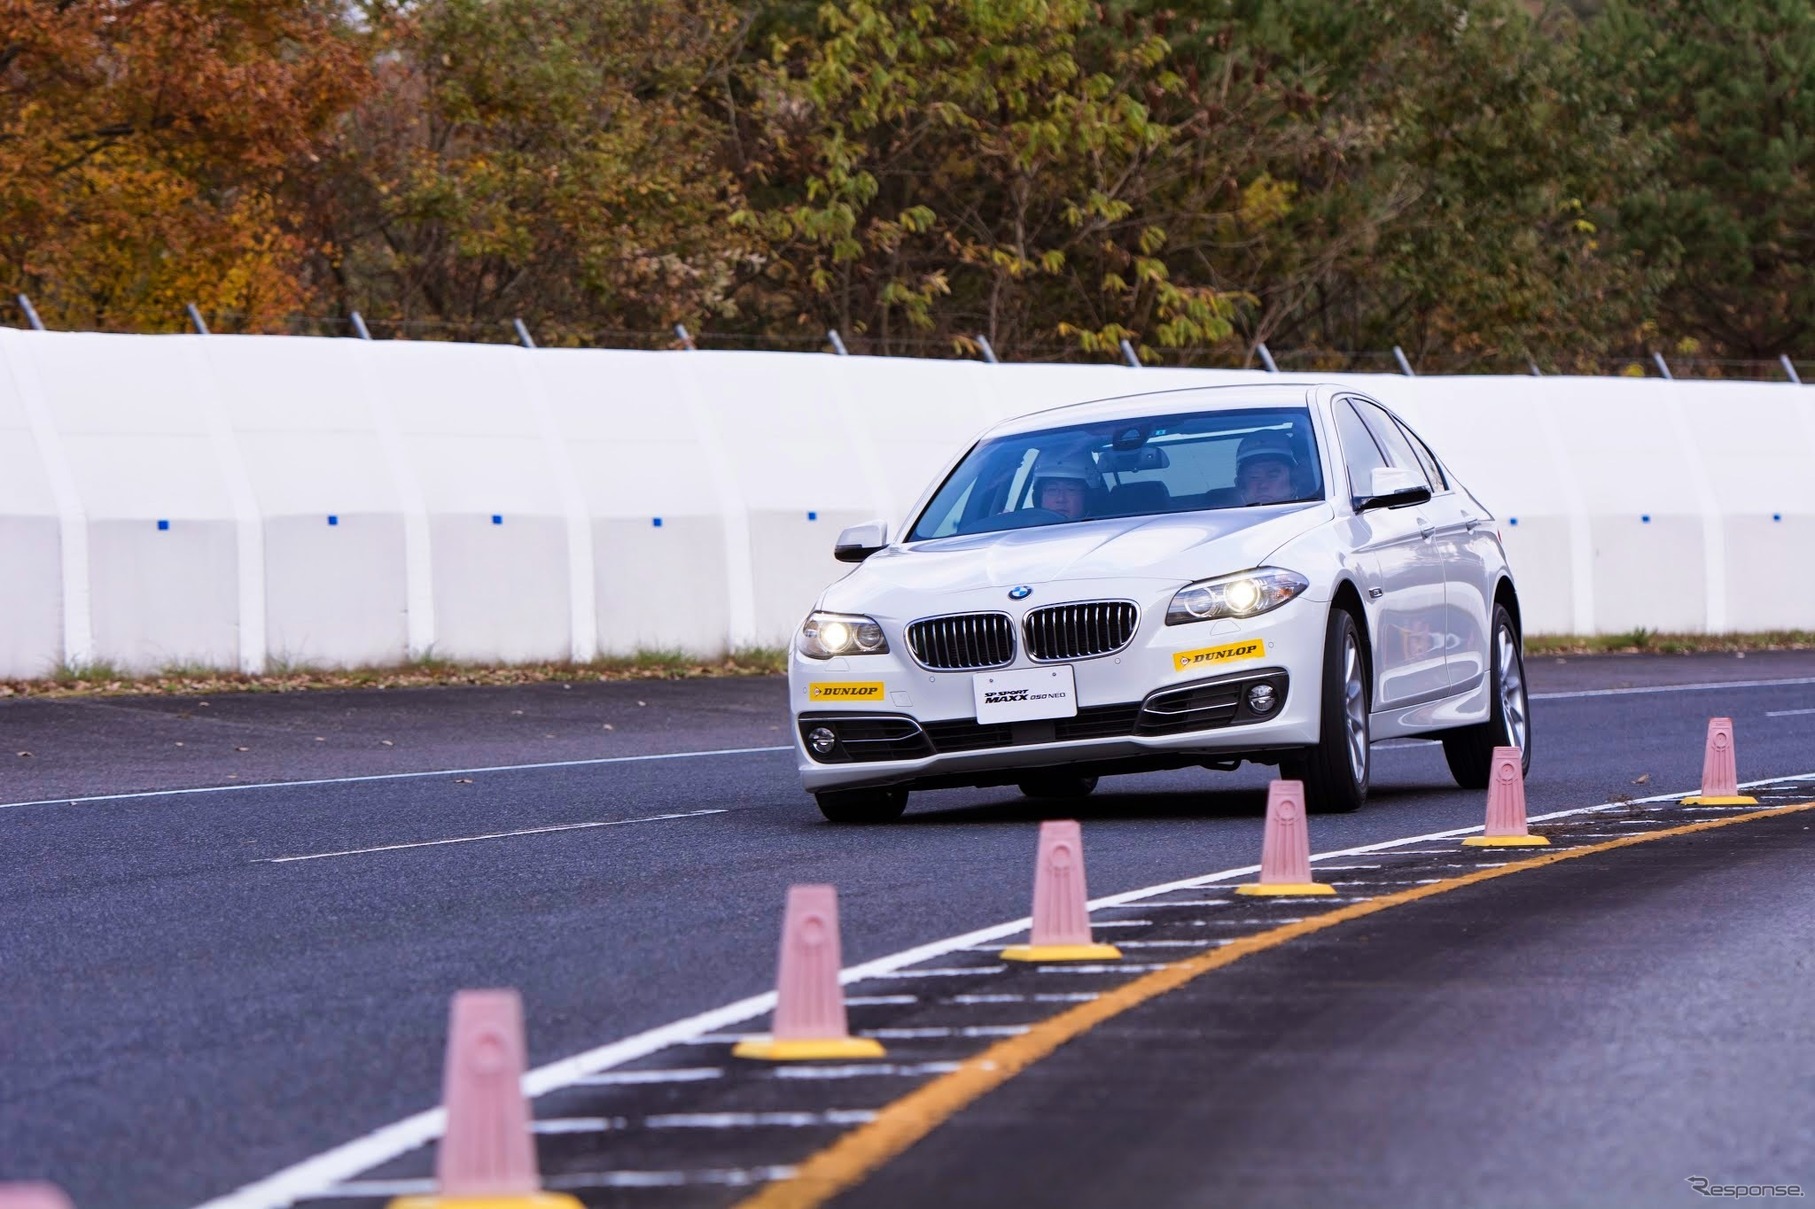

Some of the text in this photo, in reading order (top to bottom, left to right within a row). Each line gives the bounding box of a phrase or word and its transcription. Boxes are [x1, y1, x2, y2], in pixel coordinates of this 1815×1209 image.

[1193, 645, 1257, 664] DUNLOP
[823, 687, 878, 696] DUNLOP
[985, 695, 1028, 703] MAXX
